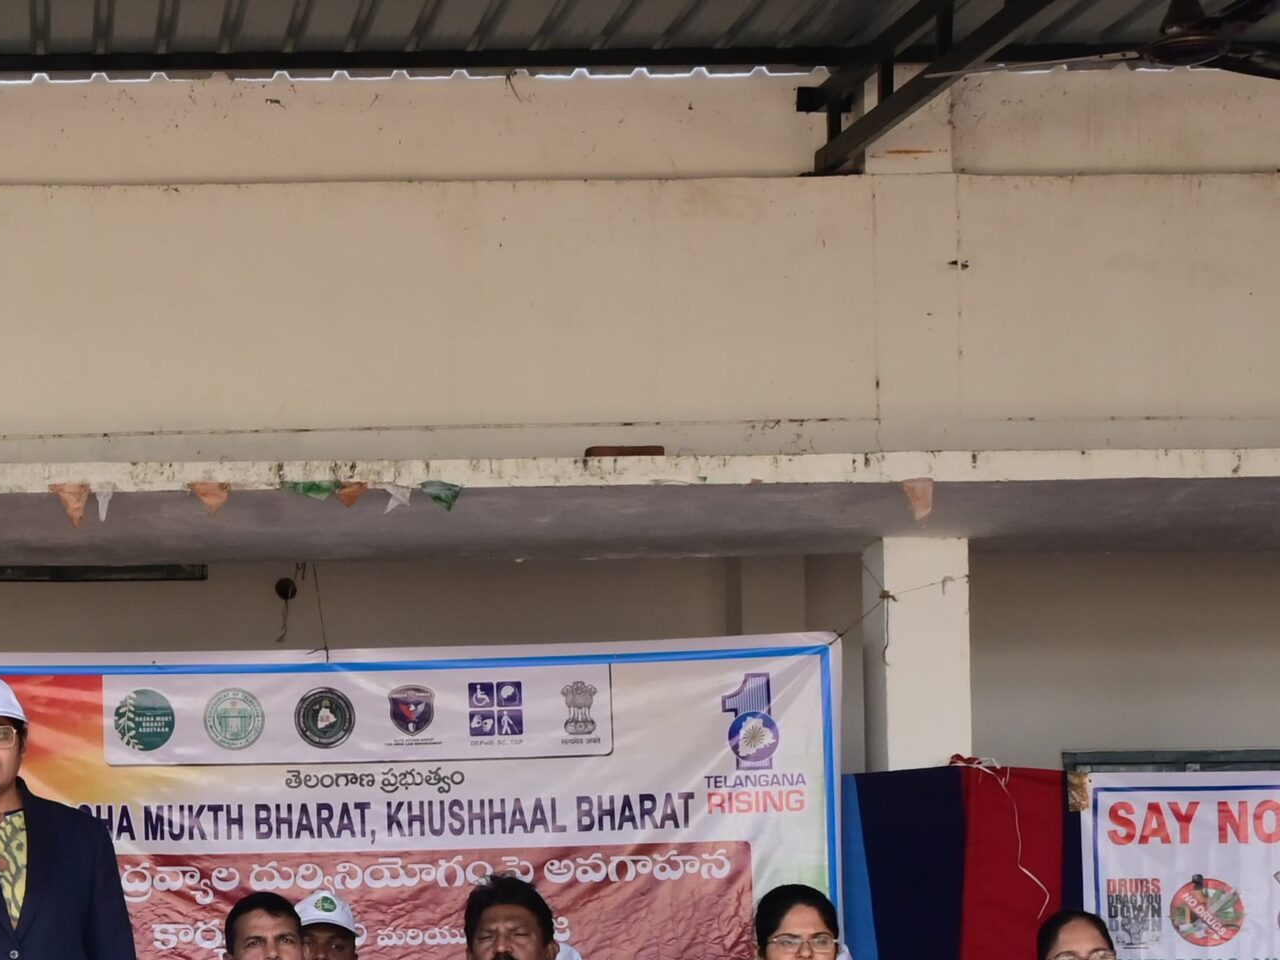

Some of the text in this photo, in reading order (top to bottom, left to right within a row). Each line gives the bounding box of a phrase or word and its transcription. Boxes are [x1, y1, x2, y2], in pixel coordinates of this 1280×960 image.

[285, 767, 465, 794] తెలంగాణ ప్రభుత్వం
[704, 773, 807, 789] TELANGANA
[707, 789, 806, 815] RISING
[143, 803, 244, 841] MUKTH
[254, 801, 376, 844] BHARAT,
[386, 795, 567, 838] KHUSHHAAL
[576, 792, 696, 834] BHARAT
[1107, 799, 1280, 845] SAY NO
[543, 849, 732, 884] అవగాహన
[1107, 878, 1161, 895] DRUGS
[1183, 892, 1228, 936] NO DRUGS
